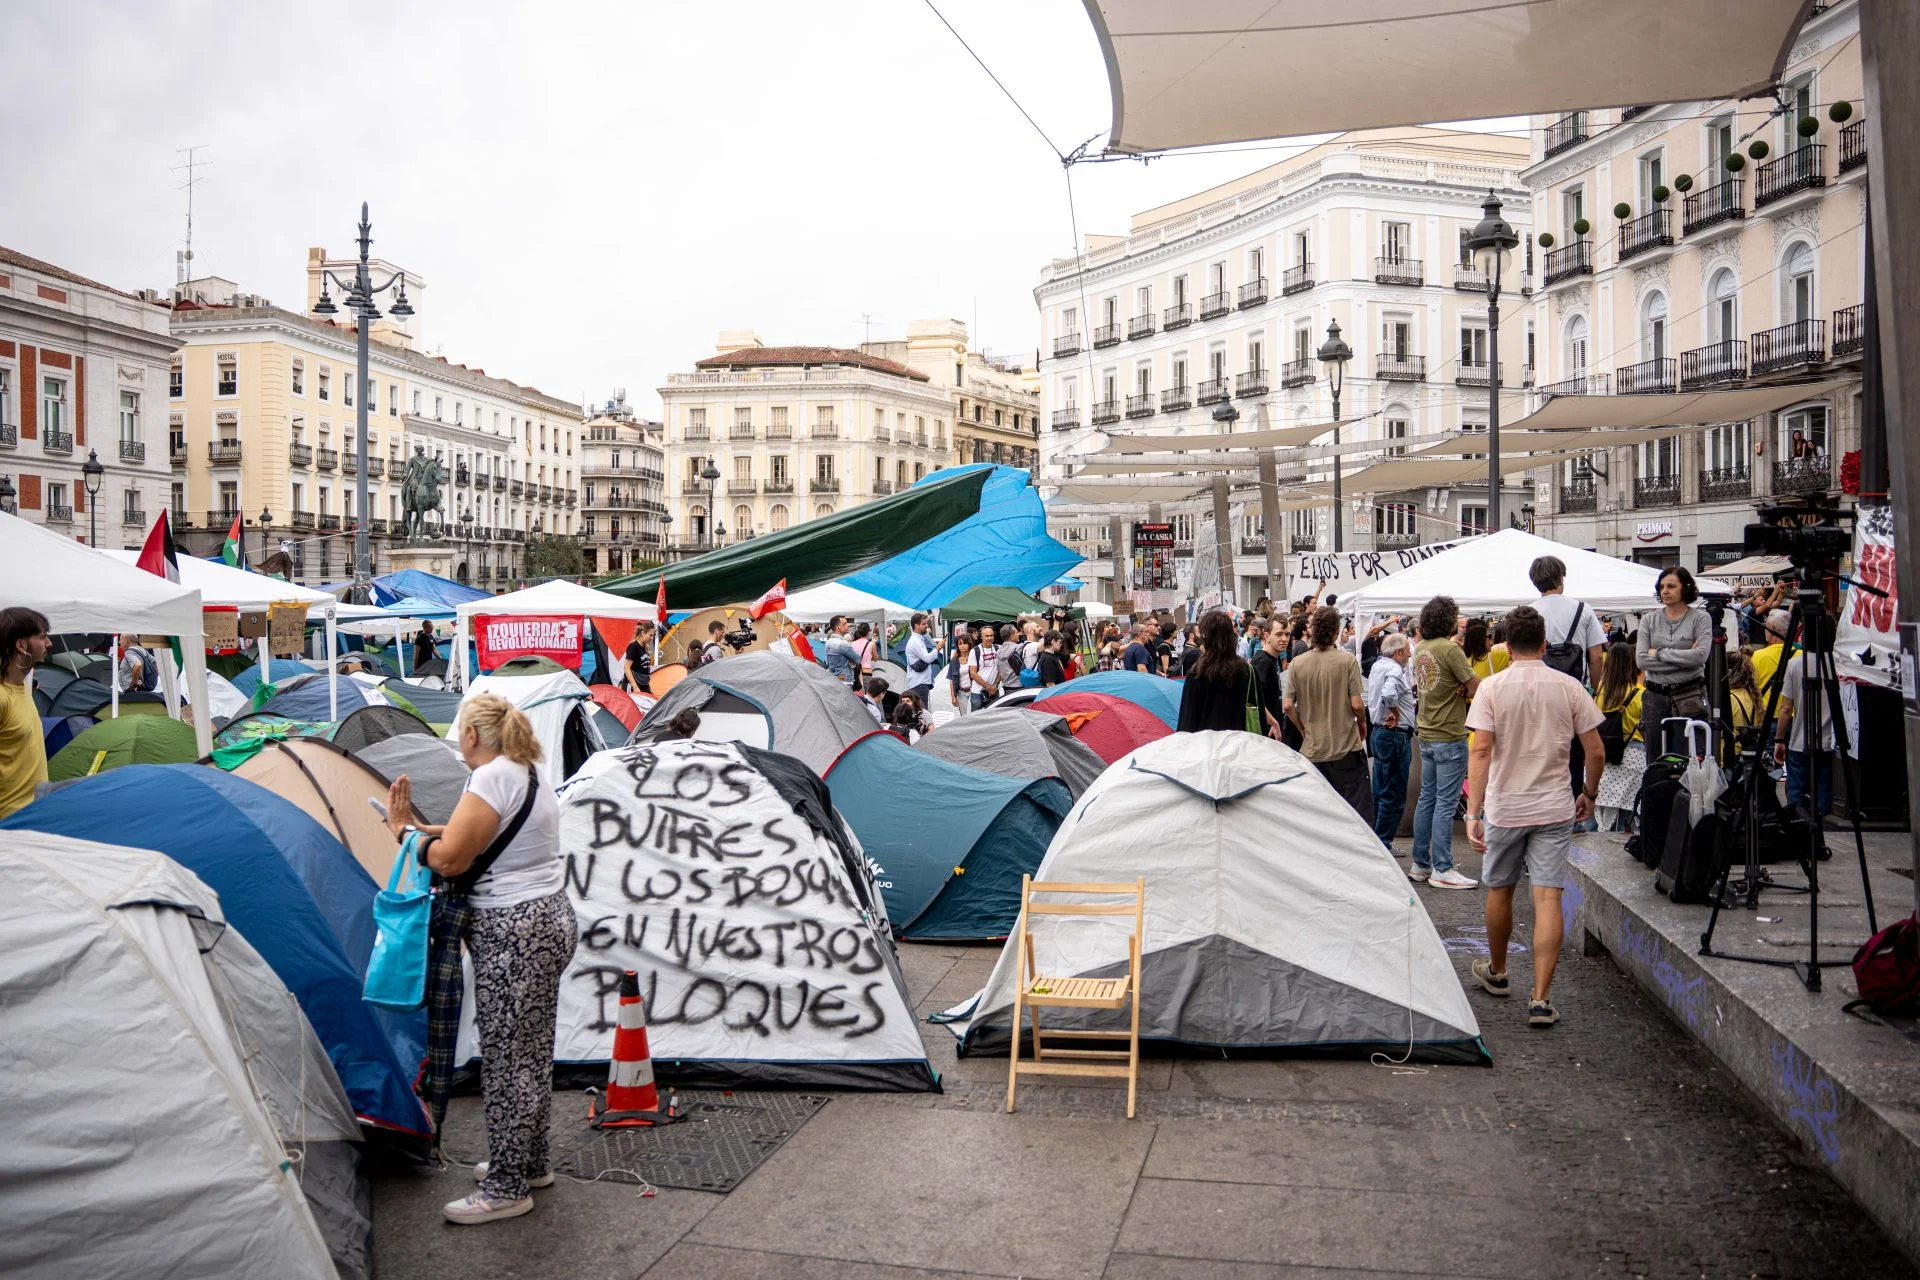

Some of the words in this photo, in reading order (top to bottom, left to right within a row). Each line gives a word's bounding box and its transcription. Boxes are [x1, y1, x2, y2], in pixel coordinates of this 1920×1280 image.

[217, 353, 236, 361] HOSTAL
[1137, 533, 1148, 541] LA
[1636, 521, 1672, 535] PRIMOR
[1715, 551, 1742, 560] rabanne
[1349, 552, 1391, 580] POR
[486, 621, 560, 639] IZQUIERDA
[488, 636, 578, 651] REVOLUCIONARIA
[629, 752, 756, 807] LOS
[571, 799, 797, 862] BUITRES
[559, 853, 597, 900] N
[620, 858, 714, 902] LOS
[580, 914, 649, 951] EN
[665, 907, 884, 975] NUESTROS
